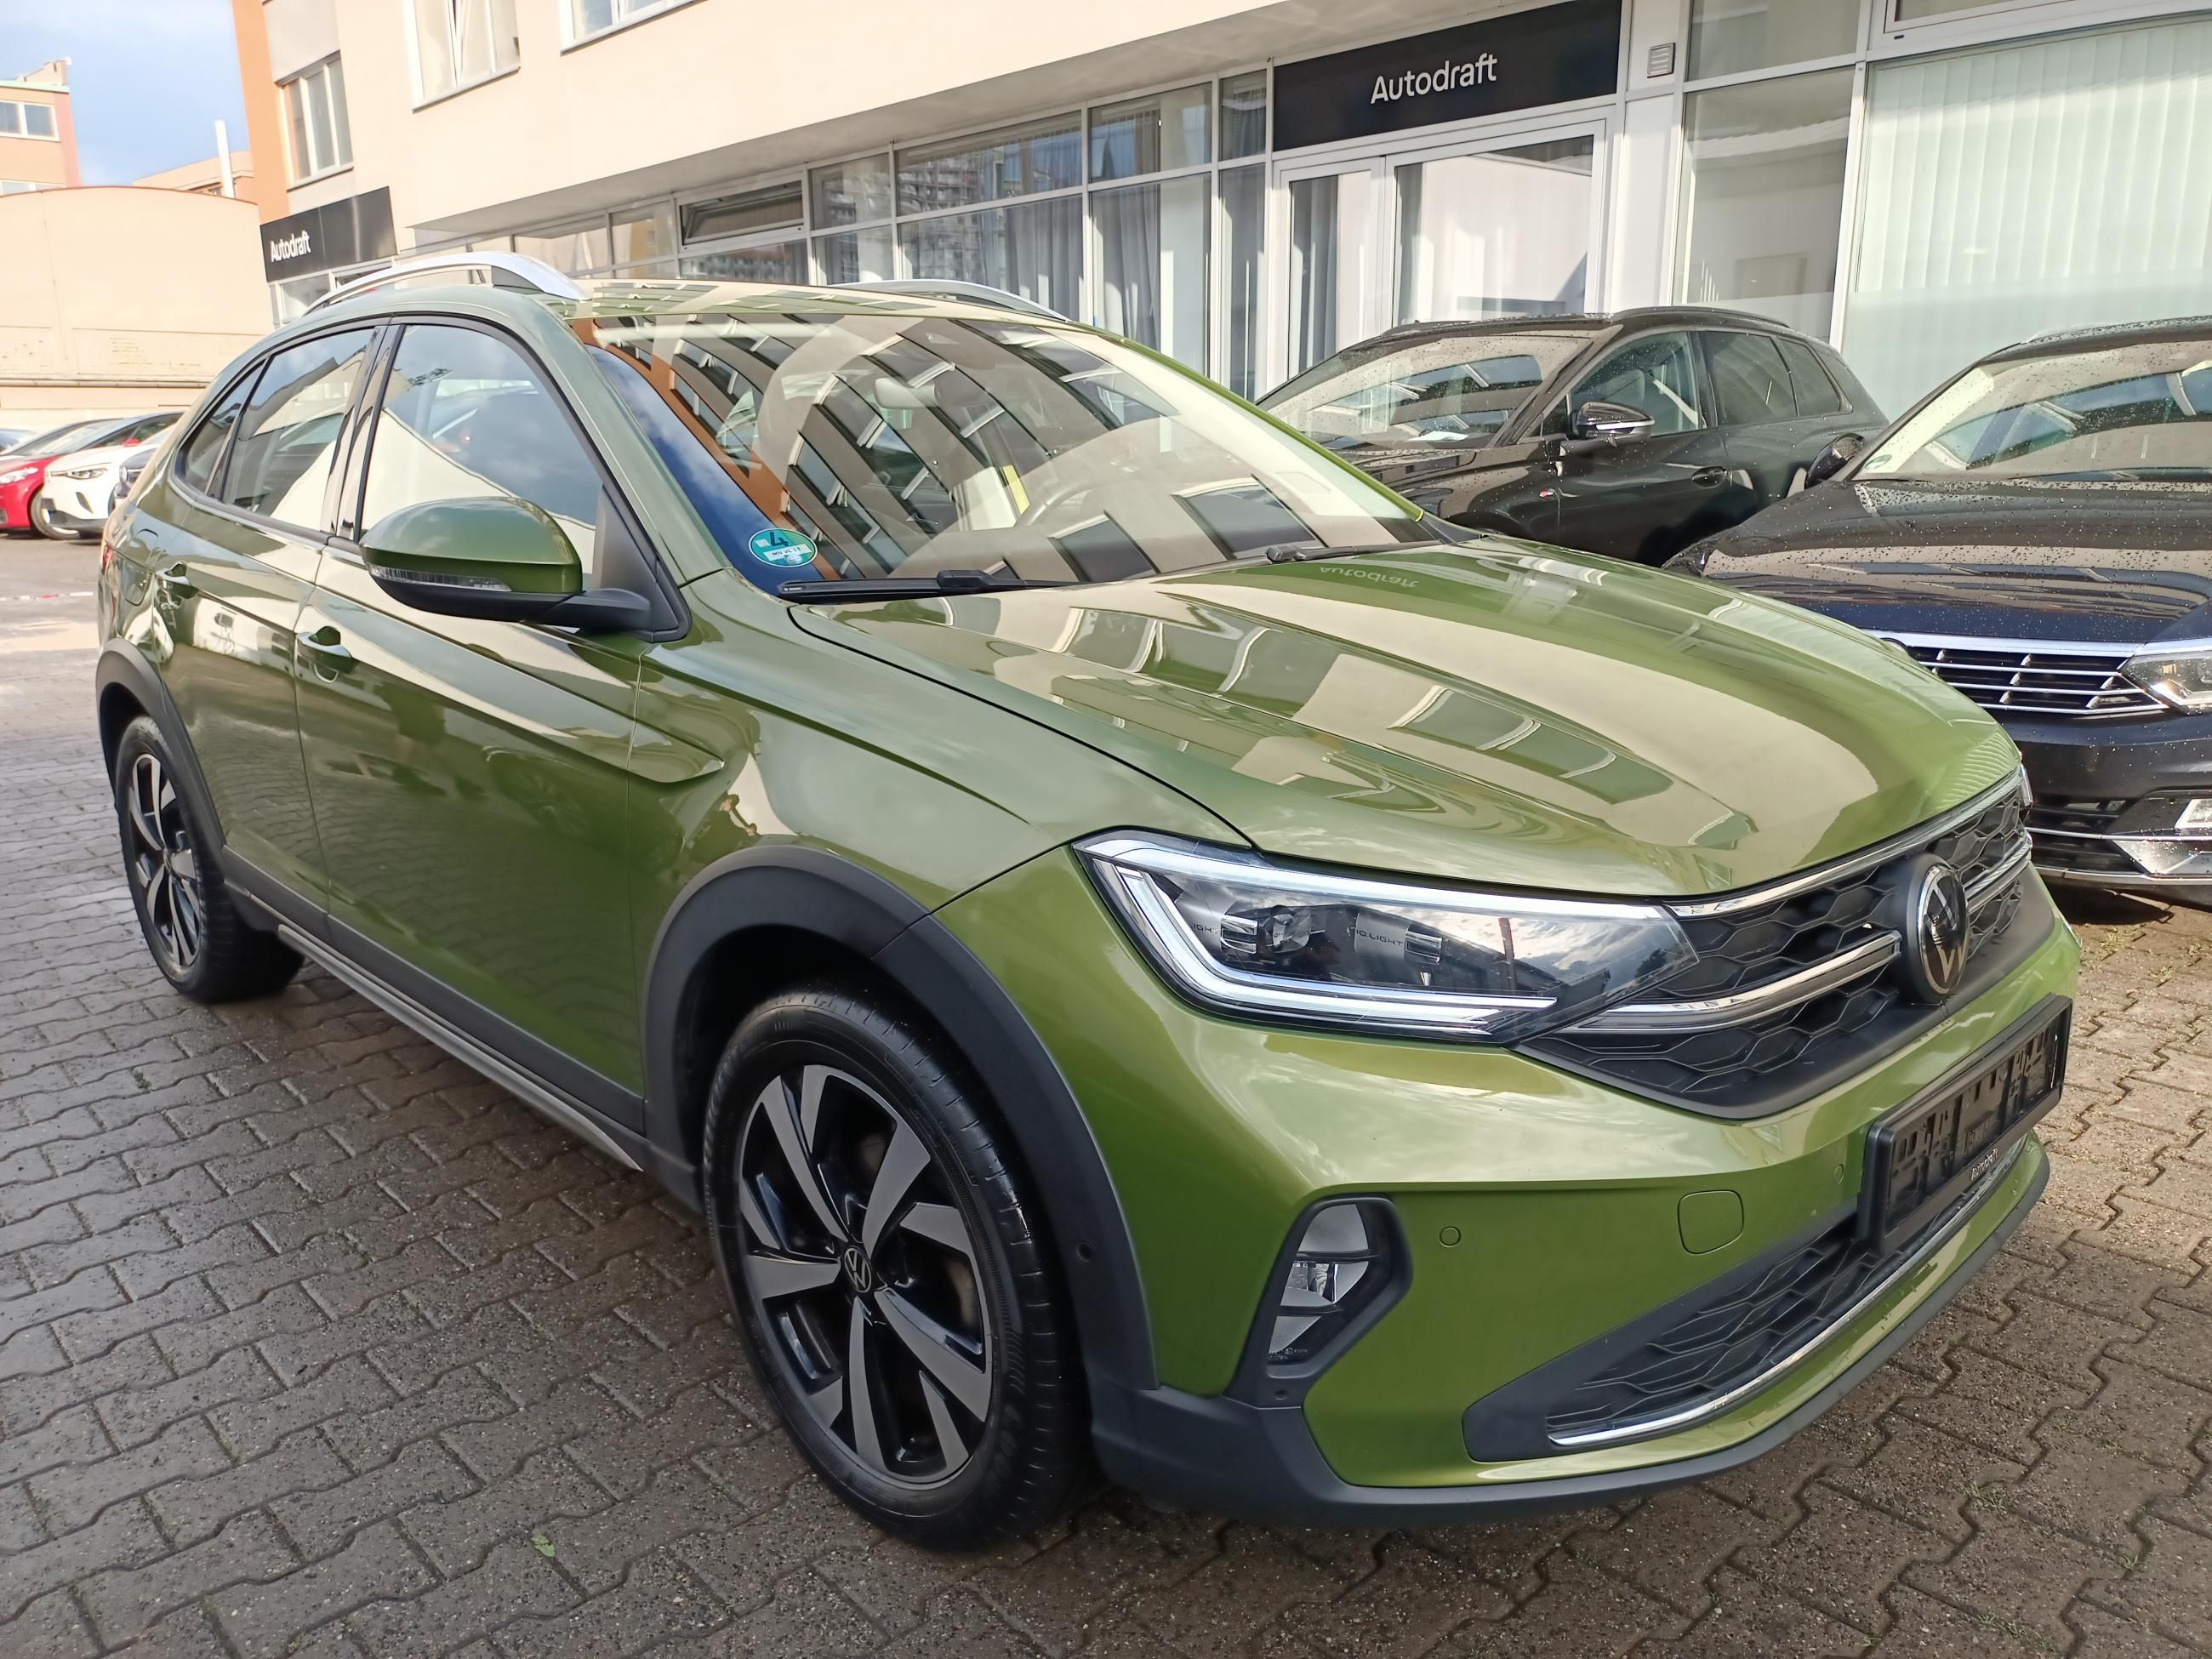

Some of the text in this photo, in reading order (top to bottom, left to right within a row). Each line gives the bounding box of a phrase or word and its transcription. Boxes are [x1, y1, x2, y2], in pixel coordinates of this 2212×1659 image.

[1371, 53, 1497, 104] Autodraft
[271, 230, 311, 262] Autodraft
[769, 531, 789, 547] 4
[1356, 929, 1403, 946] IQ.LIGHT
[845, 1249, 869, 1291] VW
